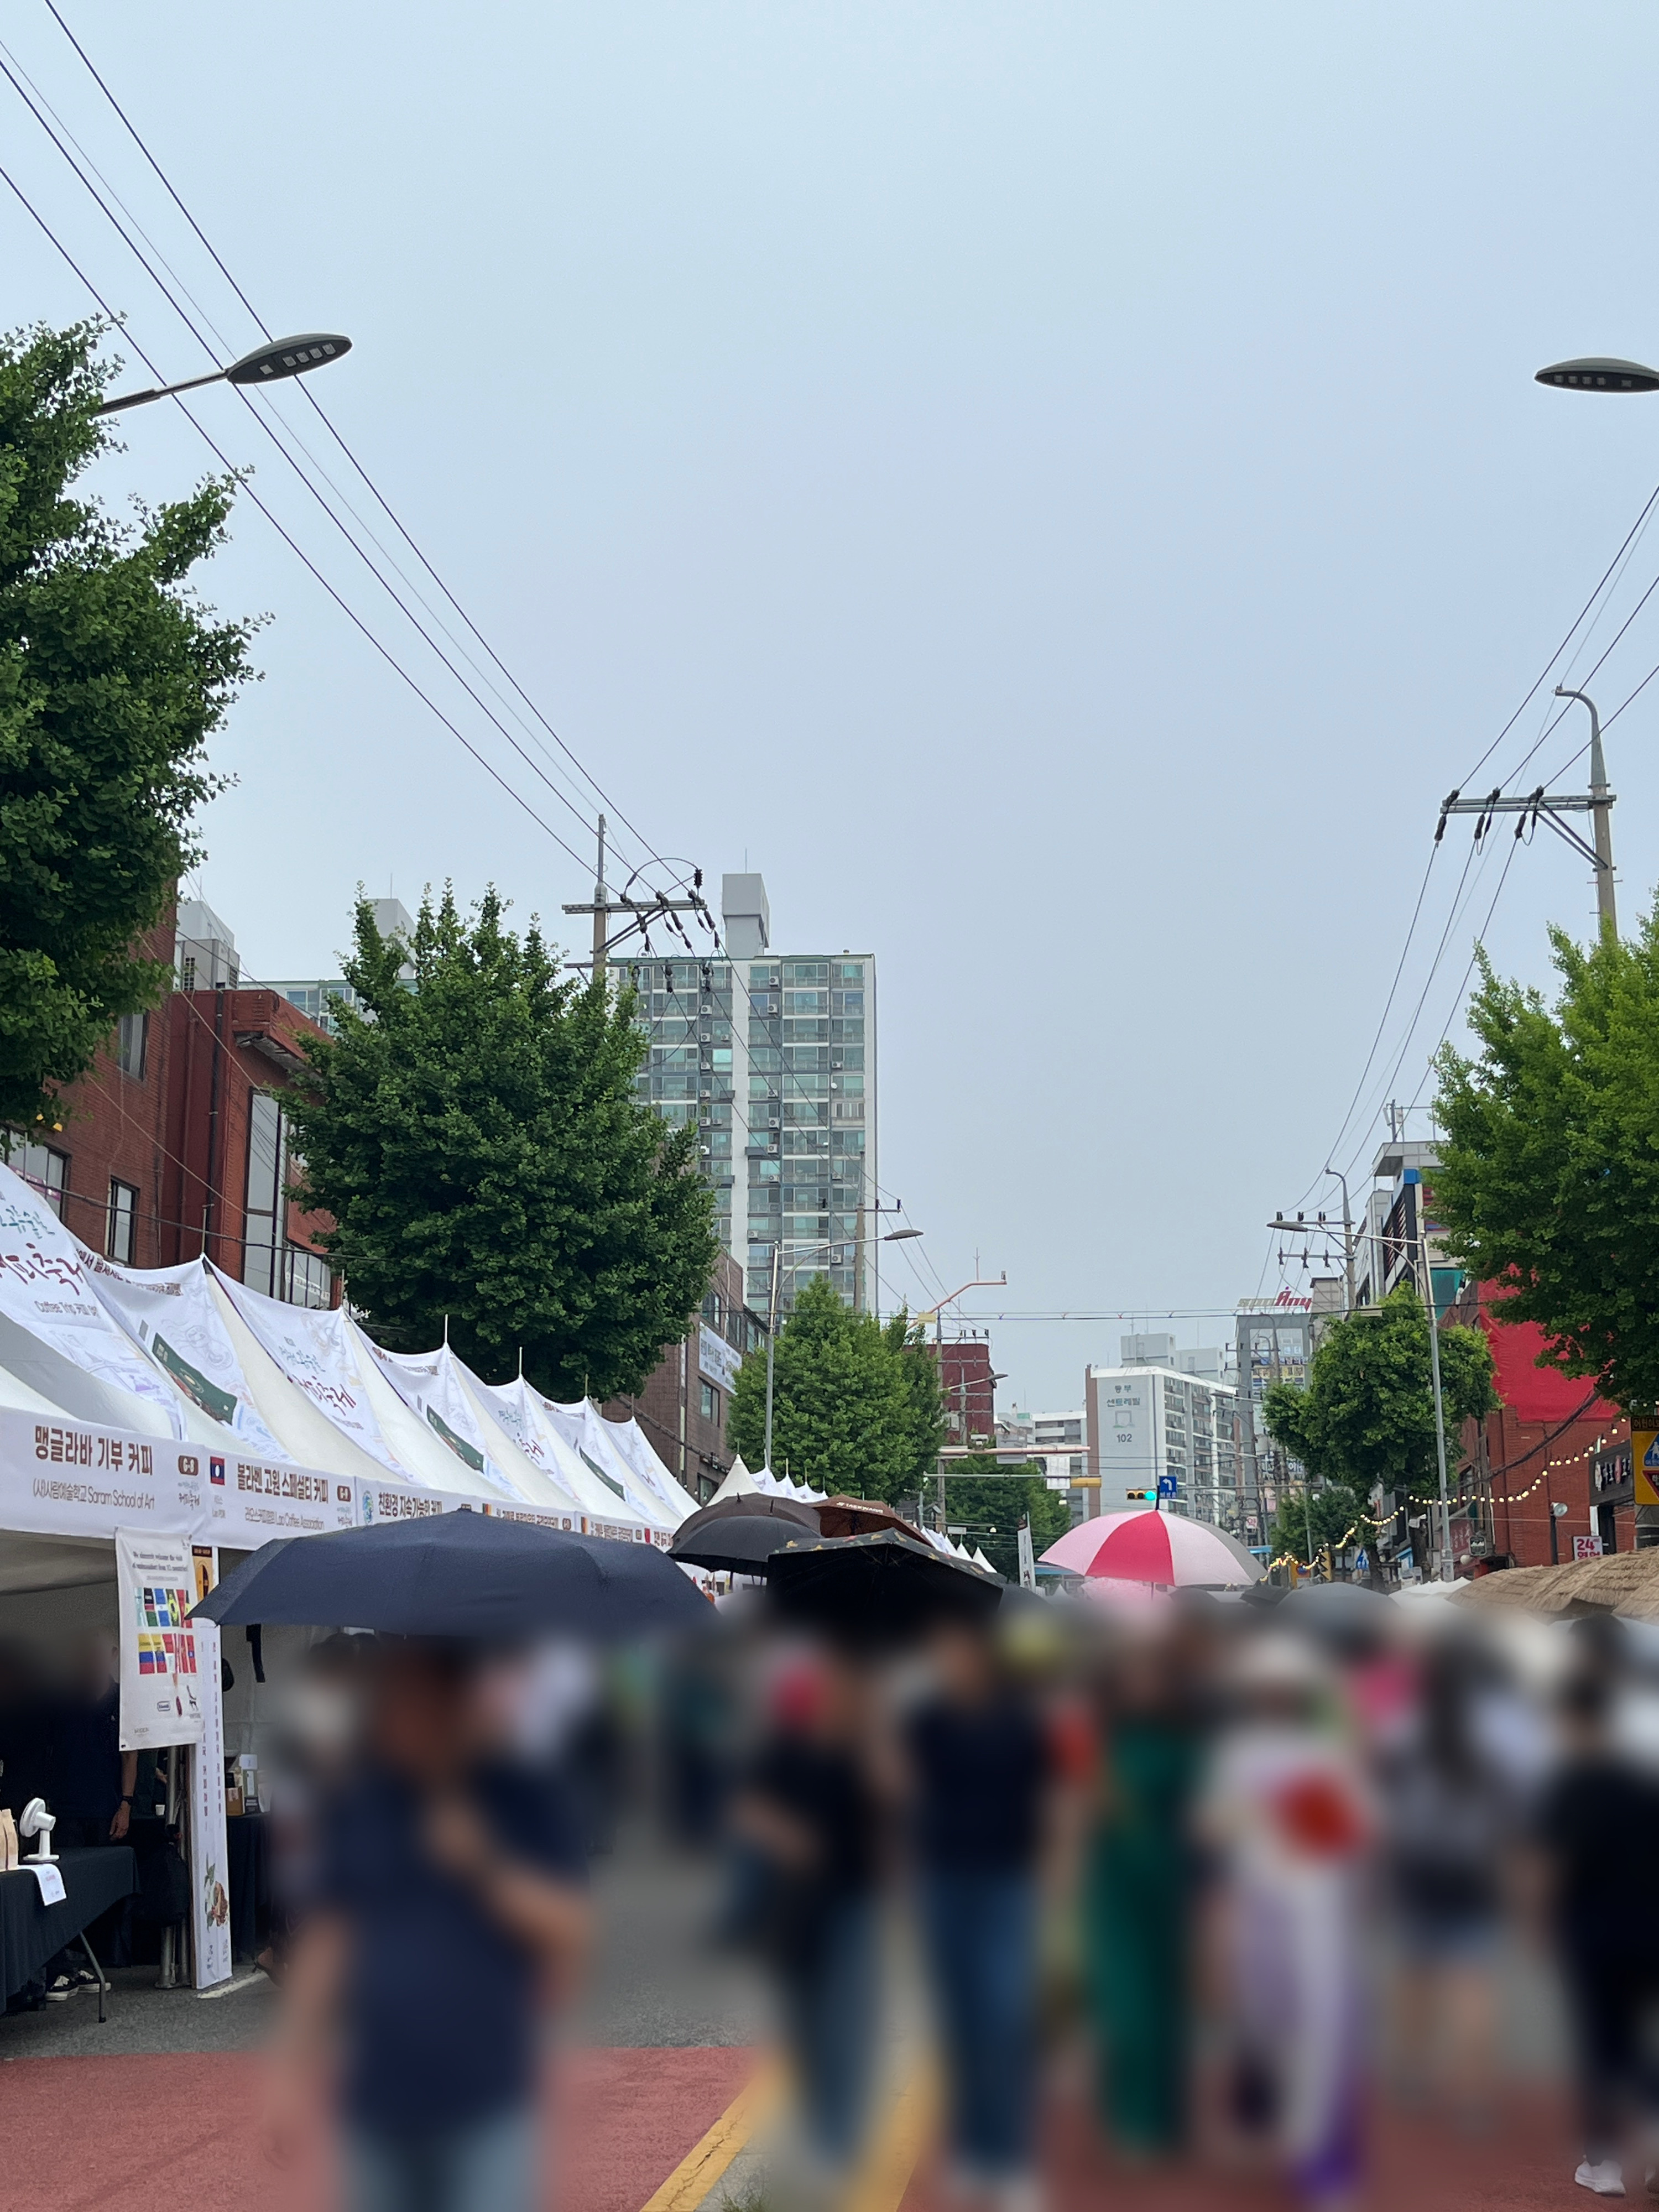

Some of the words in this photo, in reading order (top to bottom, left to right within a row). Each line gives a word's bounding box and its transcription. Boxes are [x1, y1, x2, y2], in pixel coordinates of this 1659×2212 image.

[35, 1425, 93, 1467] 맹글라바
[98, 1438, 123, 1472] 기부
[128, 1443, 153, 1475] 커피
[1117, 1433, 1132, 1443] 102
[88, 1486, 112, 1505] Saram
[113, 1489, 137, 1509] School
[137, 1492, 144, 1509] of
[144, 1493, 155, 1510] Art
[264, 1469, 280, 1496] 고원
[314, 1478, 328, 1504] 커피
[379, 1492, 398, 1517] 친환경
[1577, 1538, 1595, 1551] 24
